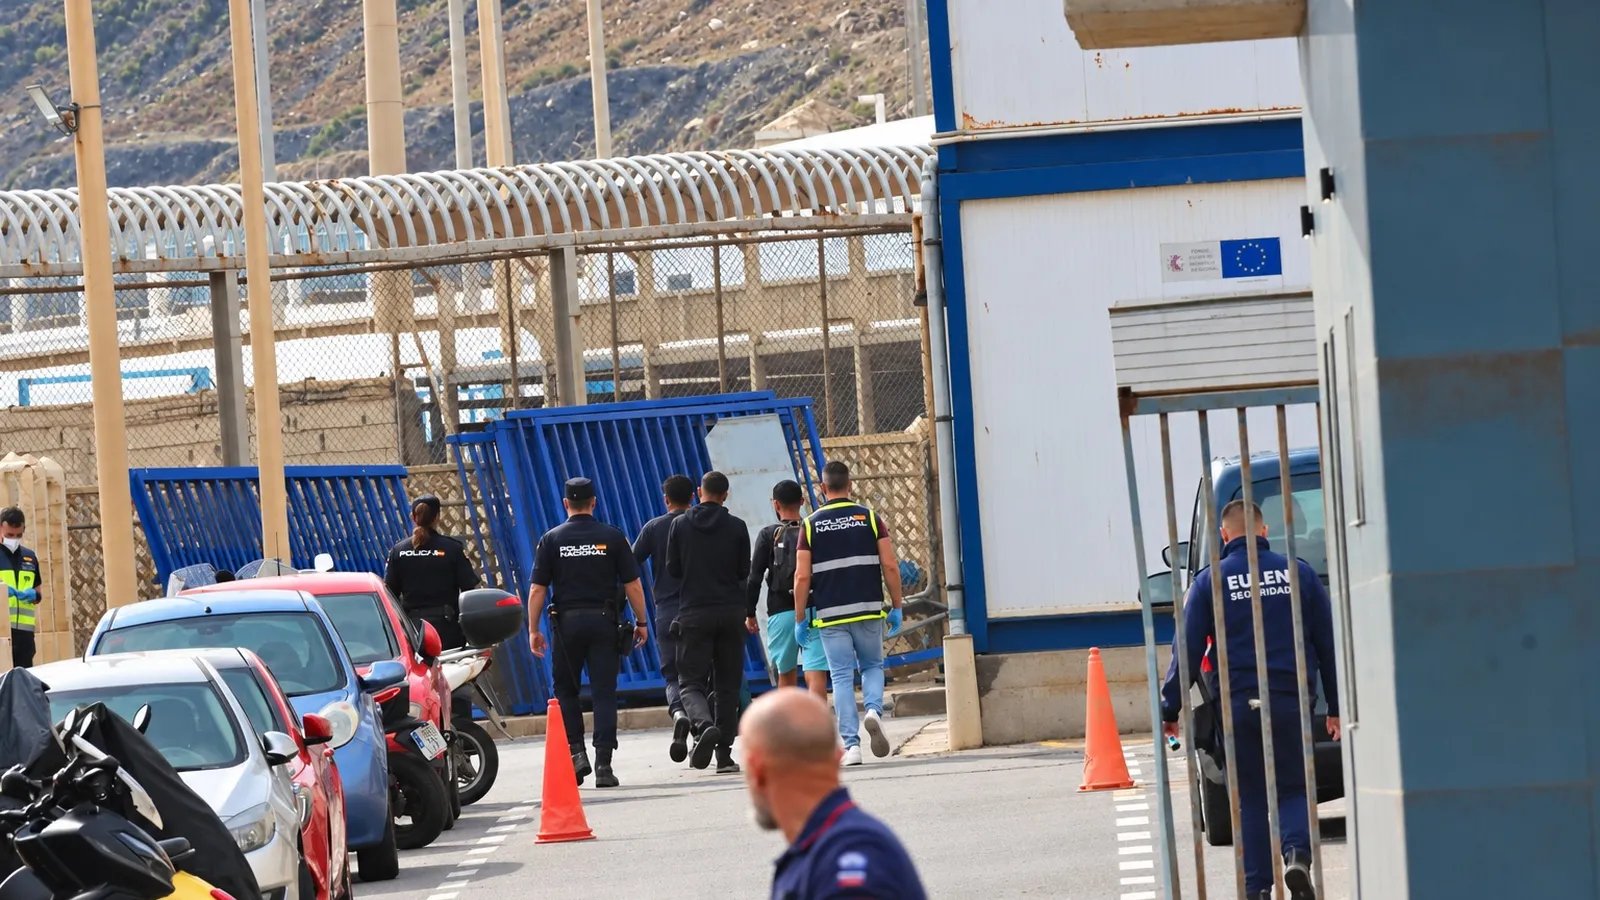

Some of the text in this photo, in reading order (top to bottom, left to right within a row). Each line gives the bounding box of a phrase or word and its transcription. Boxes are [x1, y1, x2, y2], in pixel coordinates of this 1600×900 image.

[814, 516, 855, 527] POLICIA
[815, 521, 867, 533] NACIONAL
[560, 544, 597, 552] POLICIA
[560, 549, 607, 558] NACIONAL
[1230, 585, 1292, 601] SEGRIDAD
